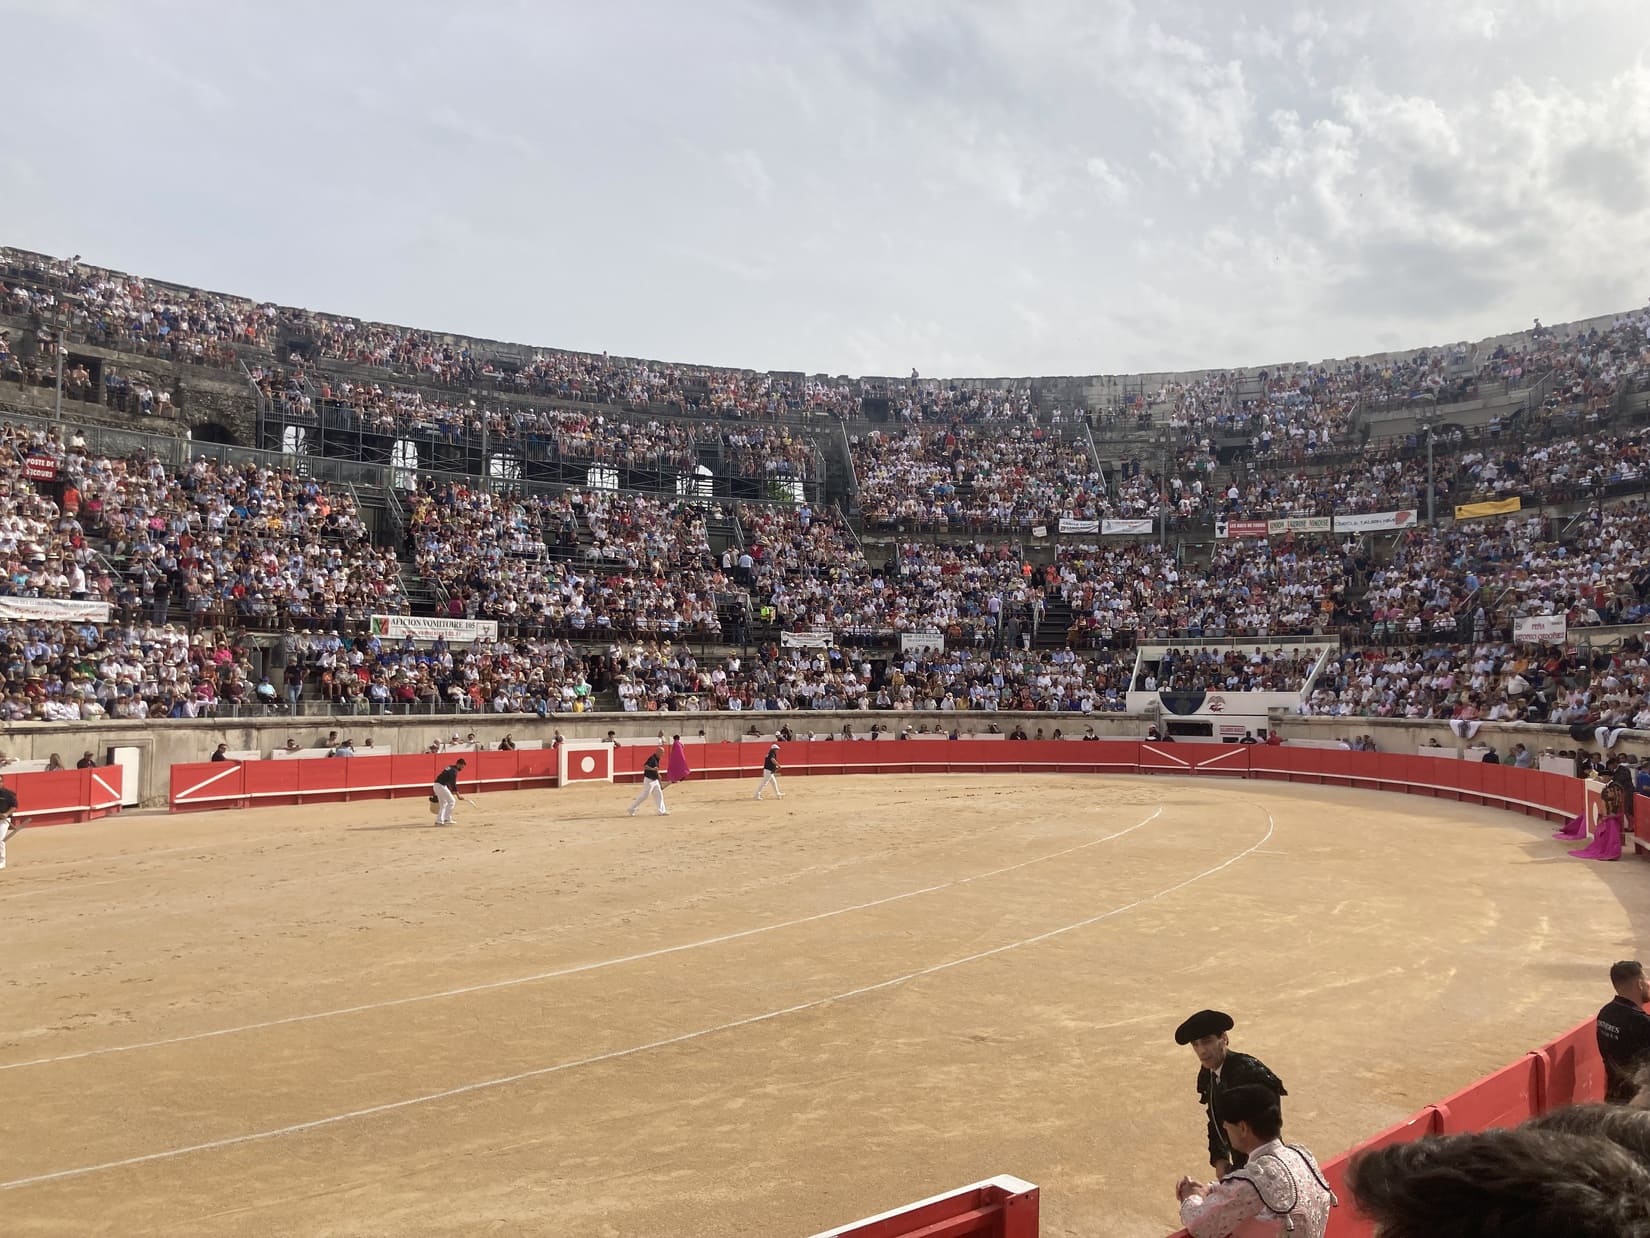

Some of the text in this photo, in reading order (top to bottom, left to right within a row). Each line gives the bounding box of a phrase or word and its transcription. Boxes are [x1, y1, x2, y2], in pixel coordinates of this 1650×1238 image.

[26, 458, 55, 468] POSTE DE
[392, 618, 420, 627] AFICION
[423, 620, 464, 629] VOMITOIRE
